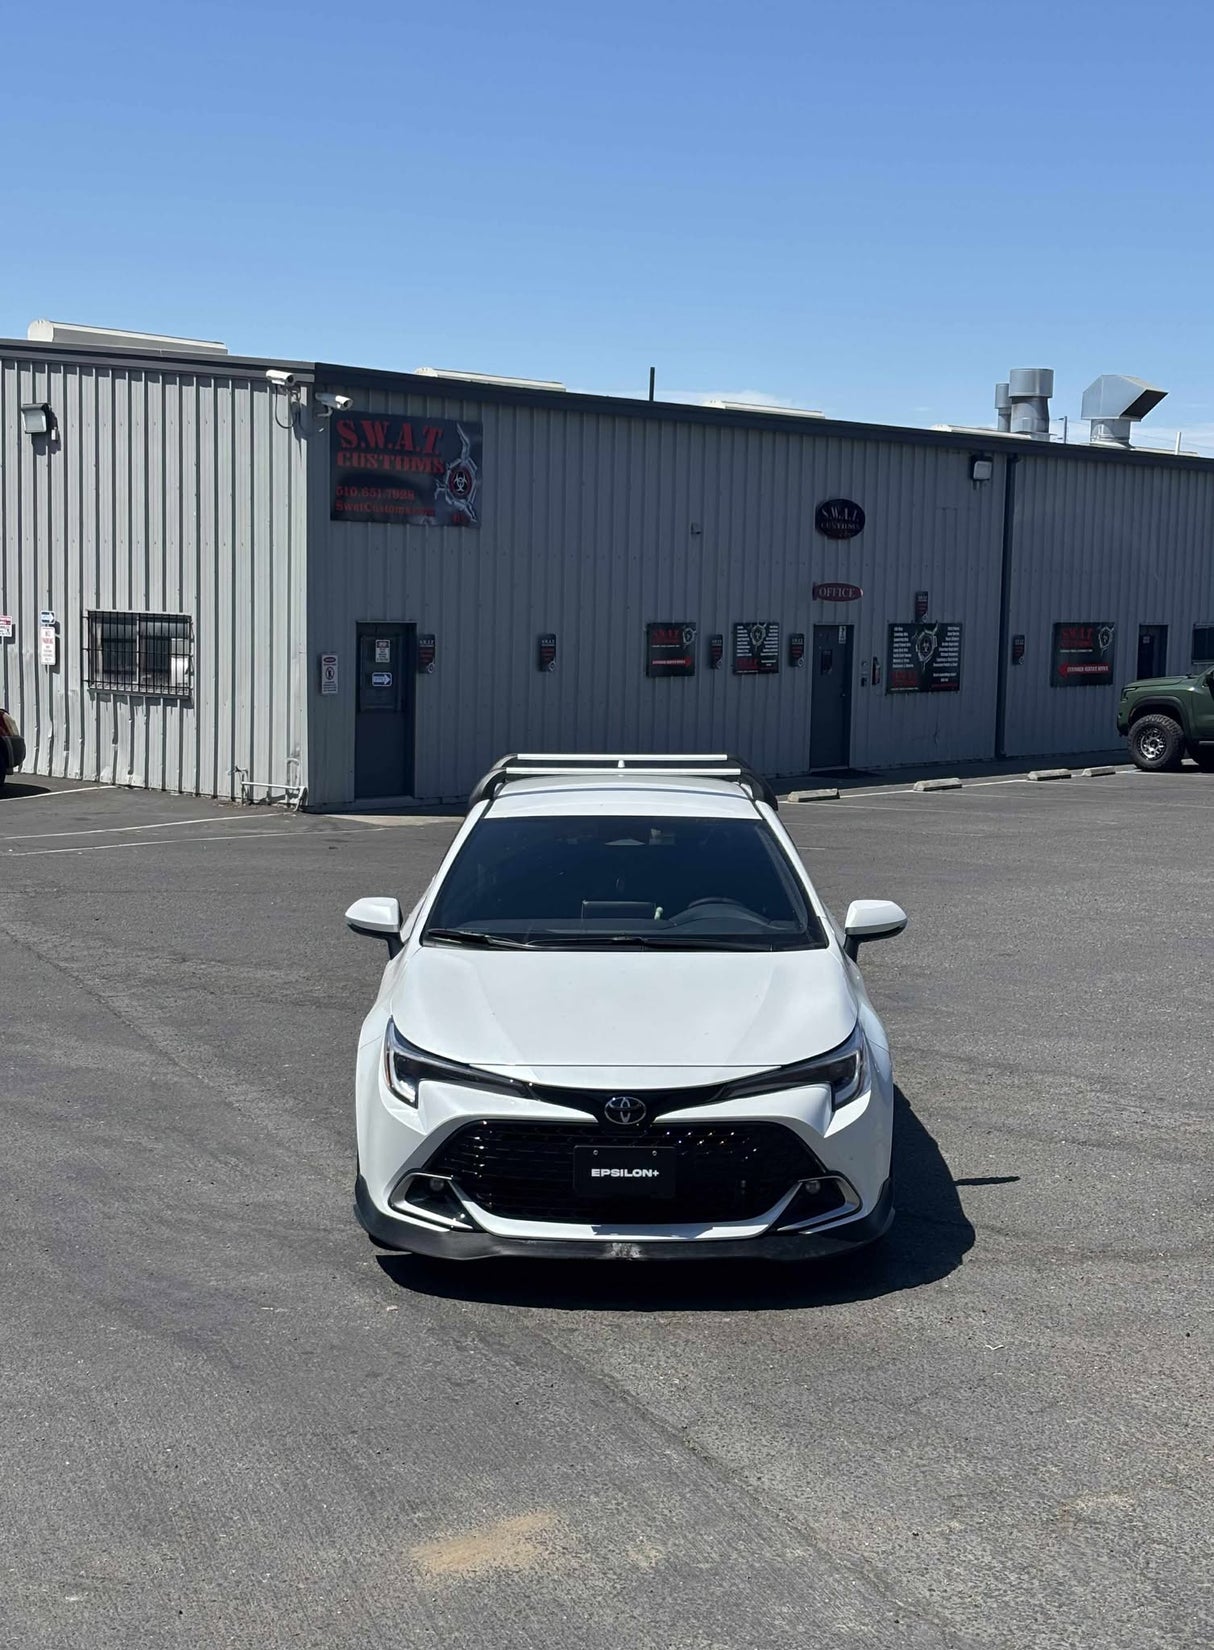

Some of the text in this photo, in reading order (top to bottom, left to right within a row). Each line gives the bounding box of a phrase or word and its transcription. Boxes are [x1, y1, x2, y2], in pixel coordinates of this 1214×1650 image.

[336, 451, 446, 474] CUSTOMS
[818, 586, 856, 599] OFFICE
[591, 1168, 660, 1178] EPSILON+
